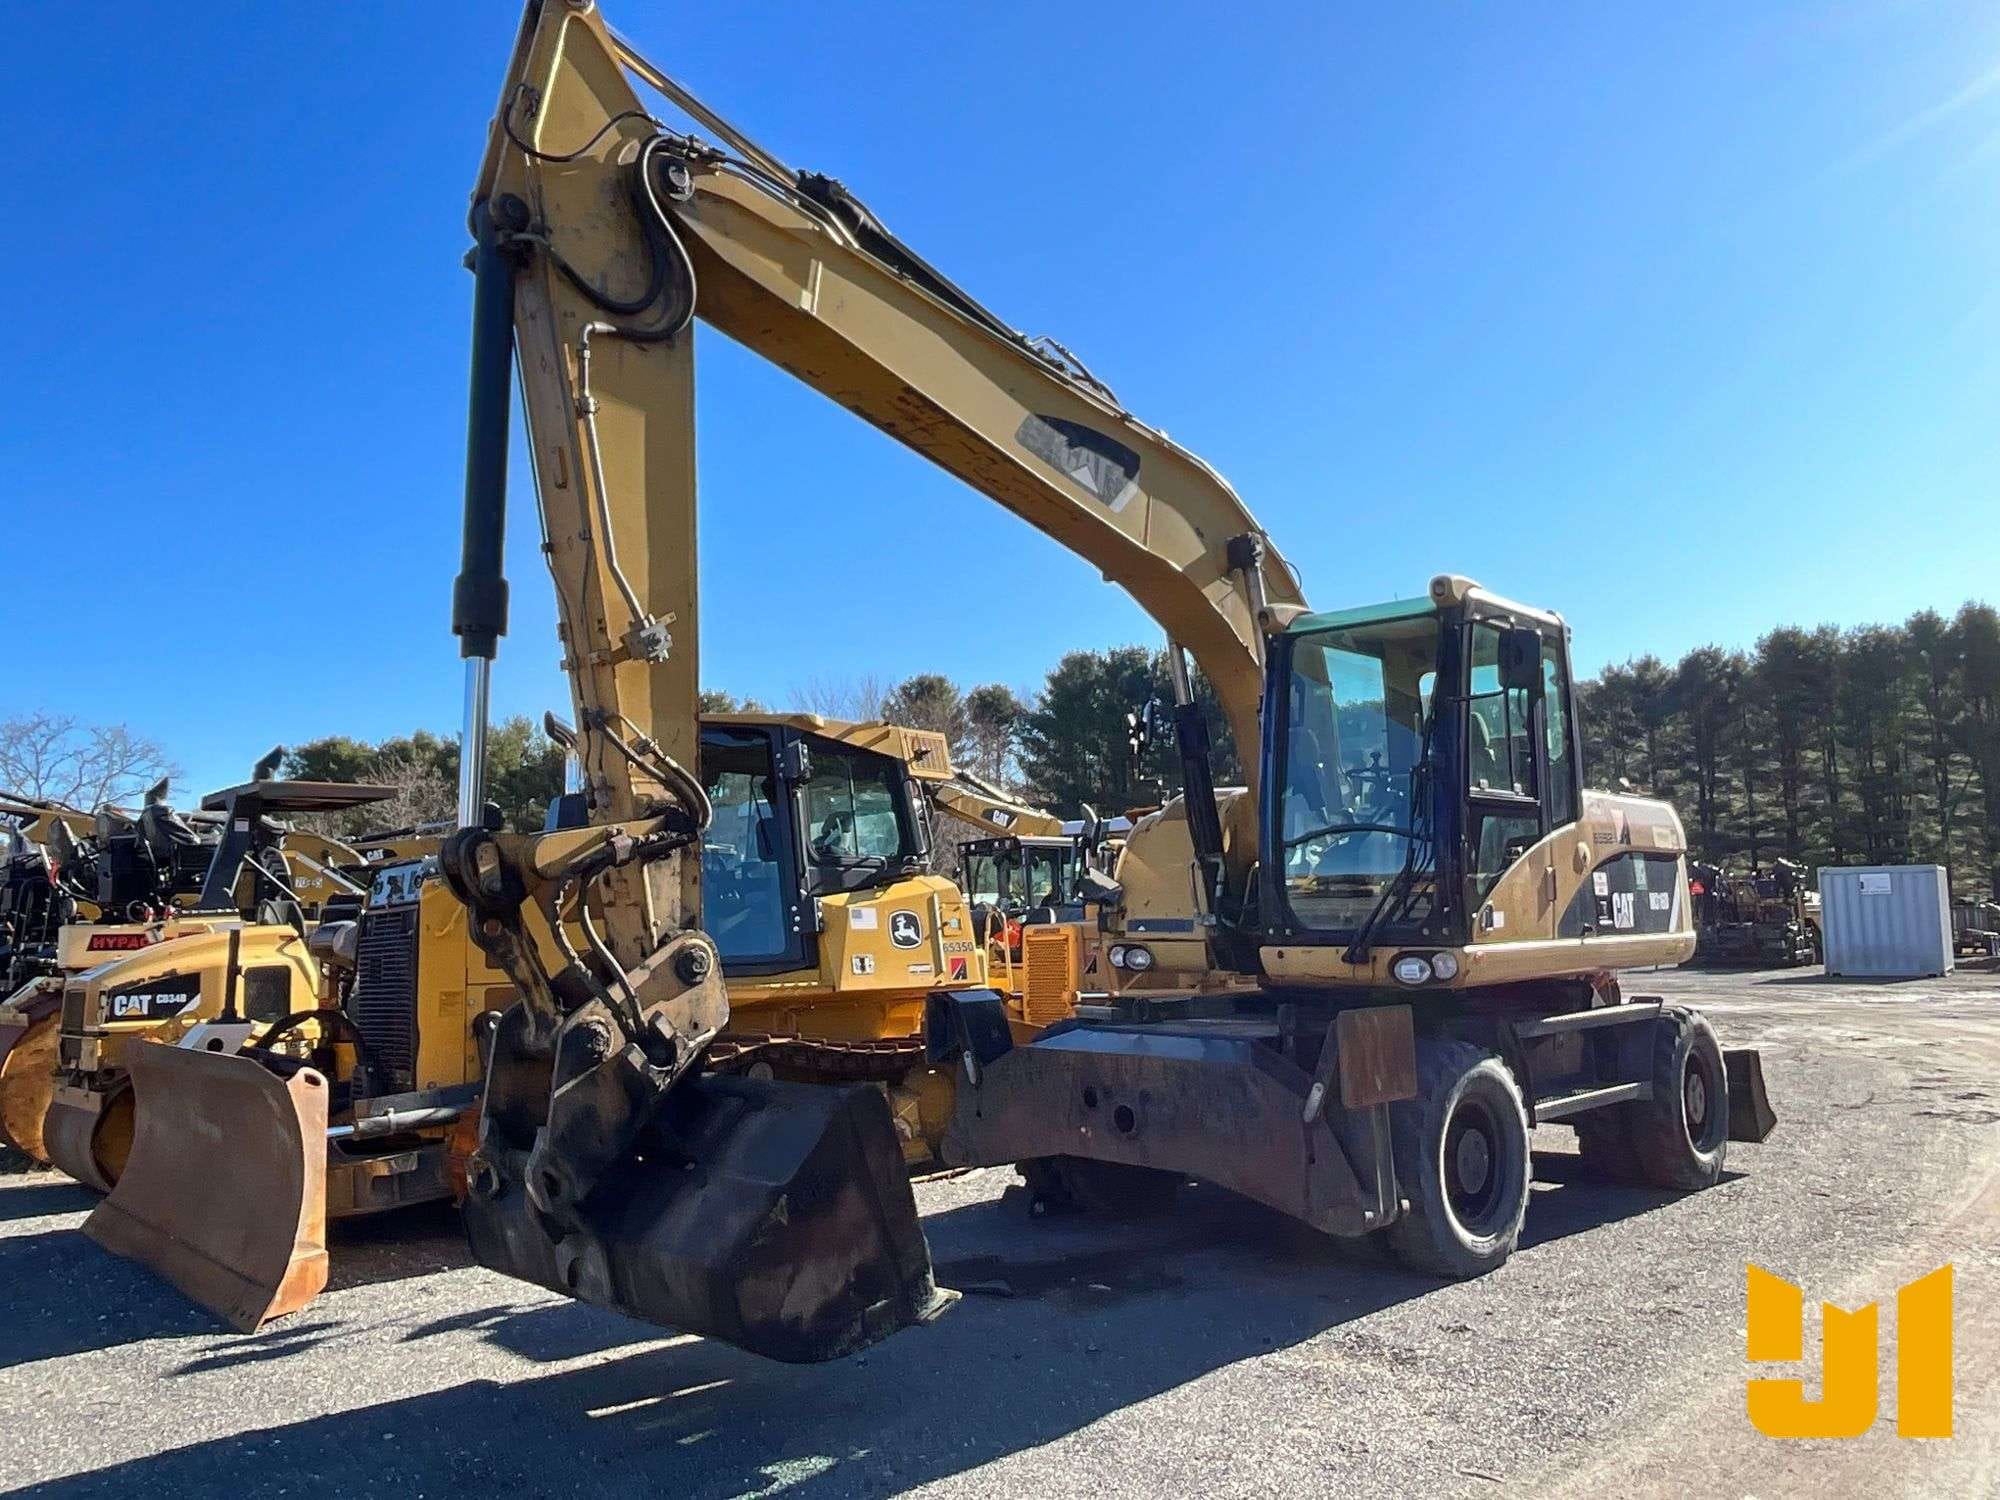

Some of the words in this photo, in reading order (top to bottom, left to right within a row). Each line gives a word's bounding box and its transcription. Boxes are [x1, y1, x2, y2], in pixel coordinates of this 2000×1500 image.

[366, 848, 384, 862] CAT
[1612, 892, 1635, 929] CAT
[114, 994, 152, 1016] CAT
